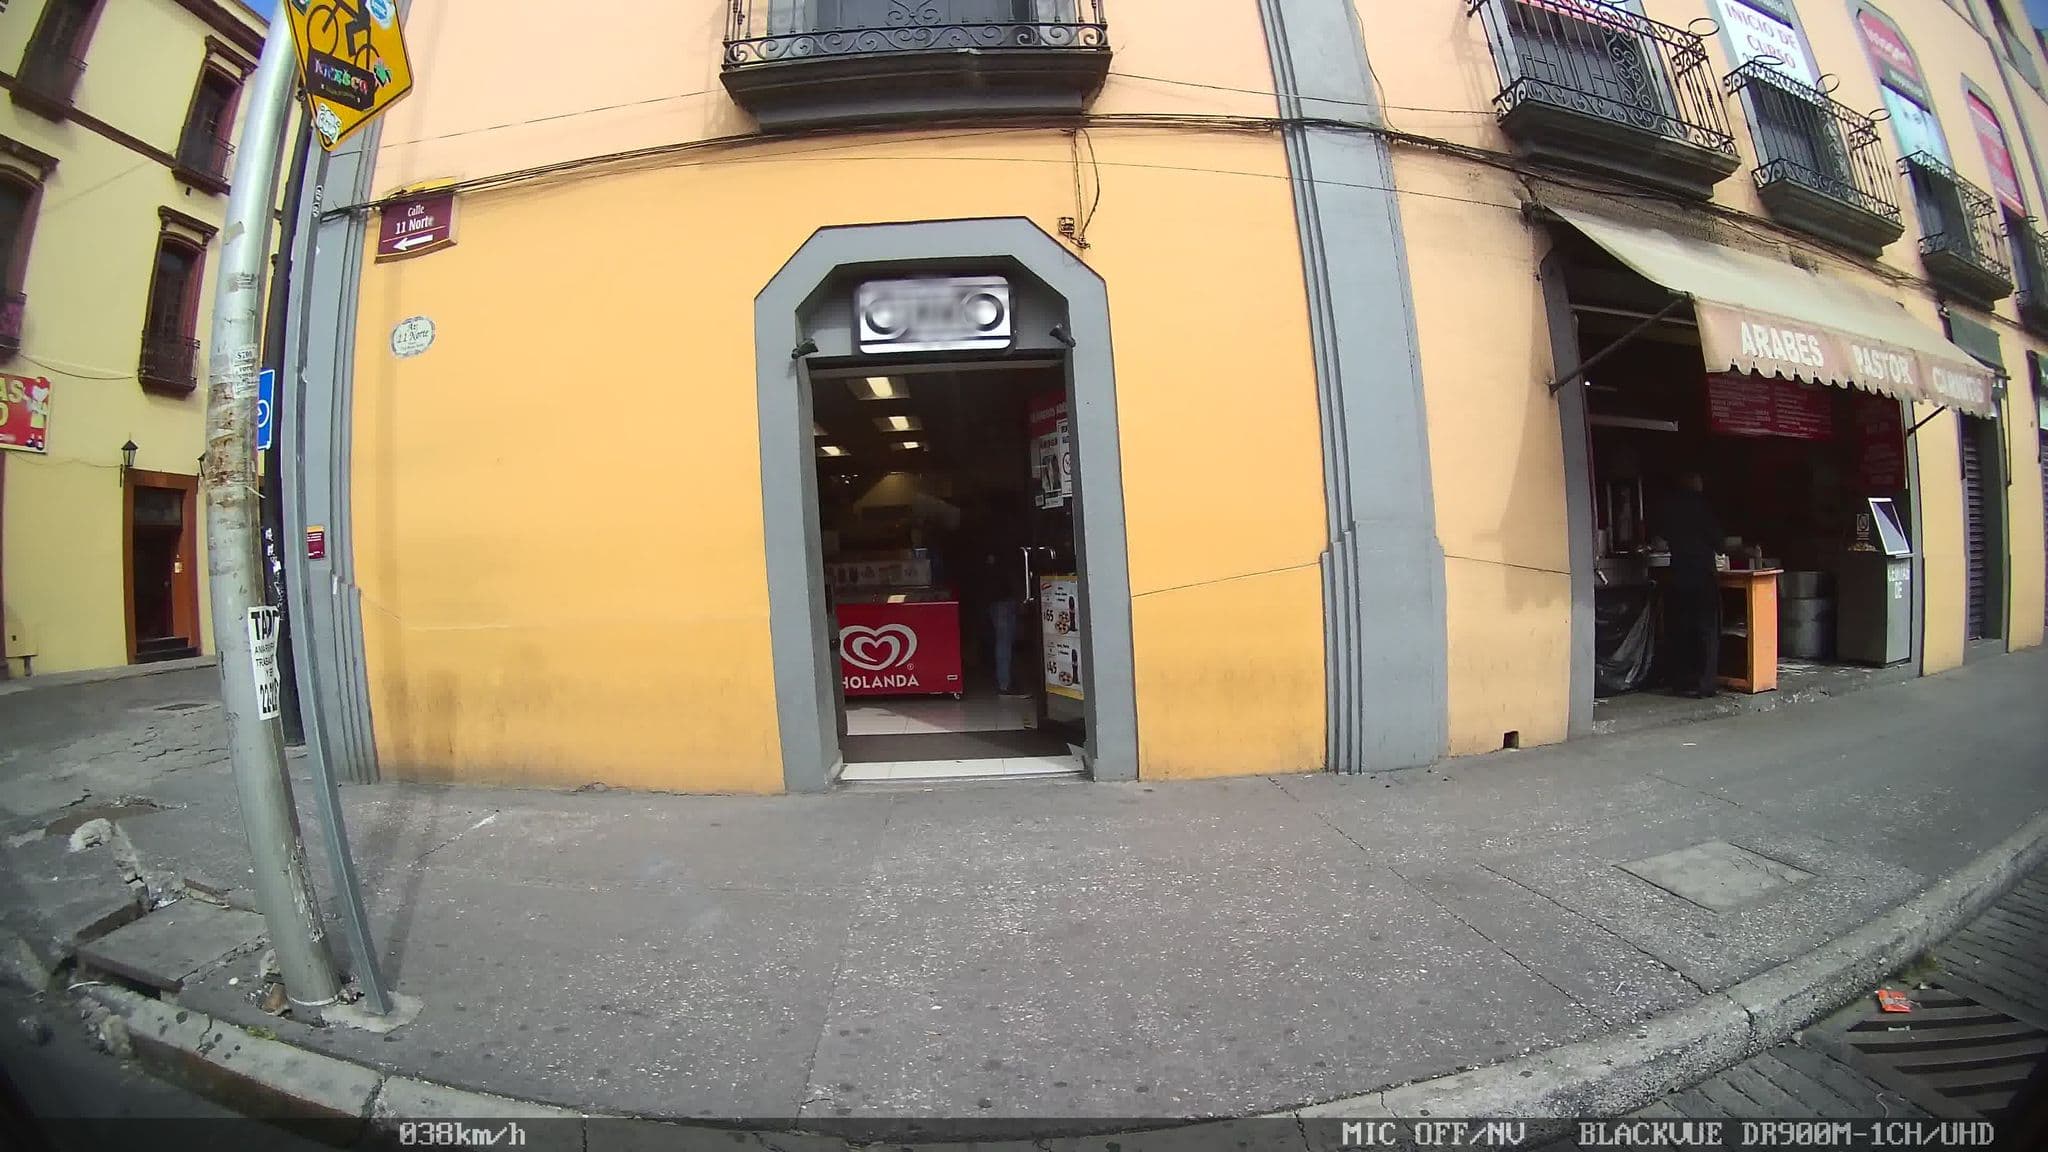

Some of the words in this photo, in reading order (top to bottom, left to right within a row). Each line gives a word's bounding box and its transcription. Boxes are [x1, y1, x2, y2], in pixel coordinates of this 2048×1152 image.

[1725, 3, 1775, 38] INICIO
[1778, 29, 1798, 50] DE
[1747, 34, 1796, 69] CURSO
[395, 221, 406, 235] 11
[409, 216, 434, 232] Norte
[408, 204, 425, 217] Calle
[1741, 322, 1825, 368] ARABES
[1852, 344, 1913, 385] PASTOR
